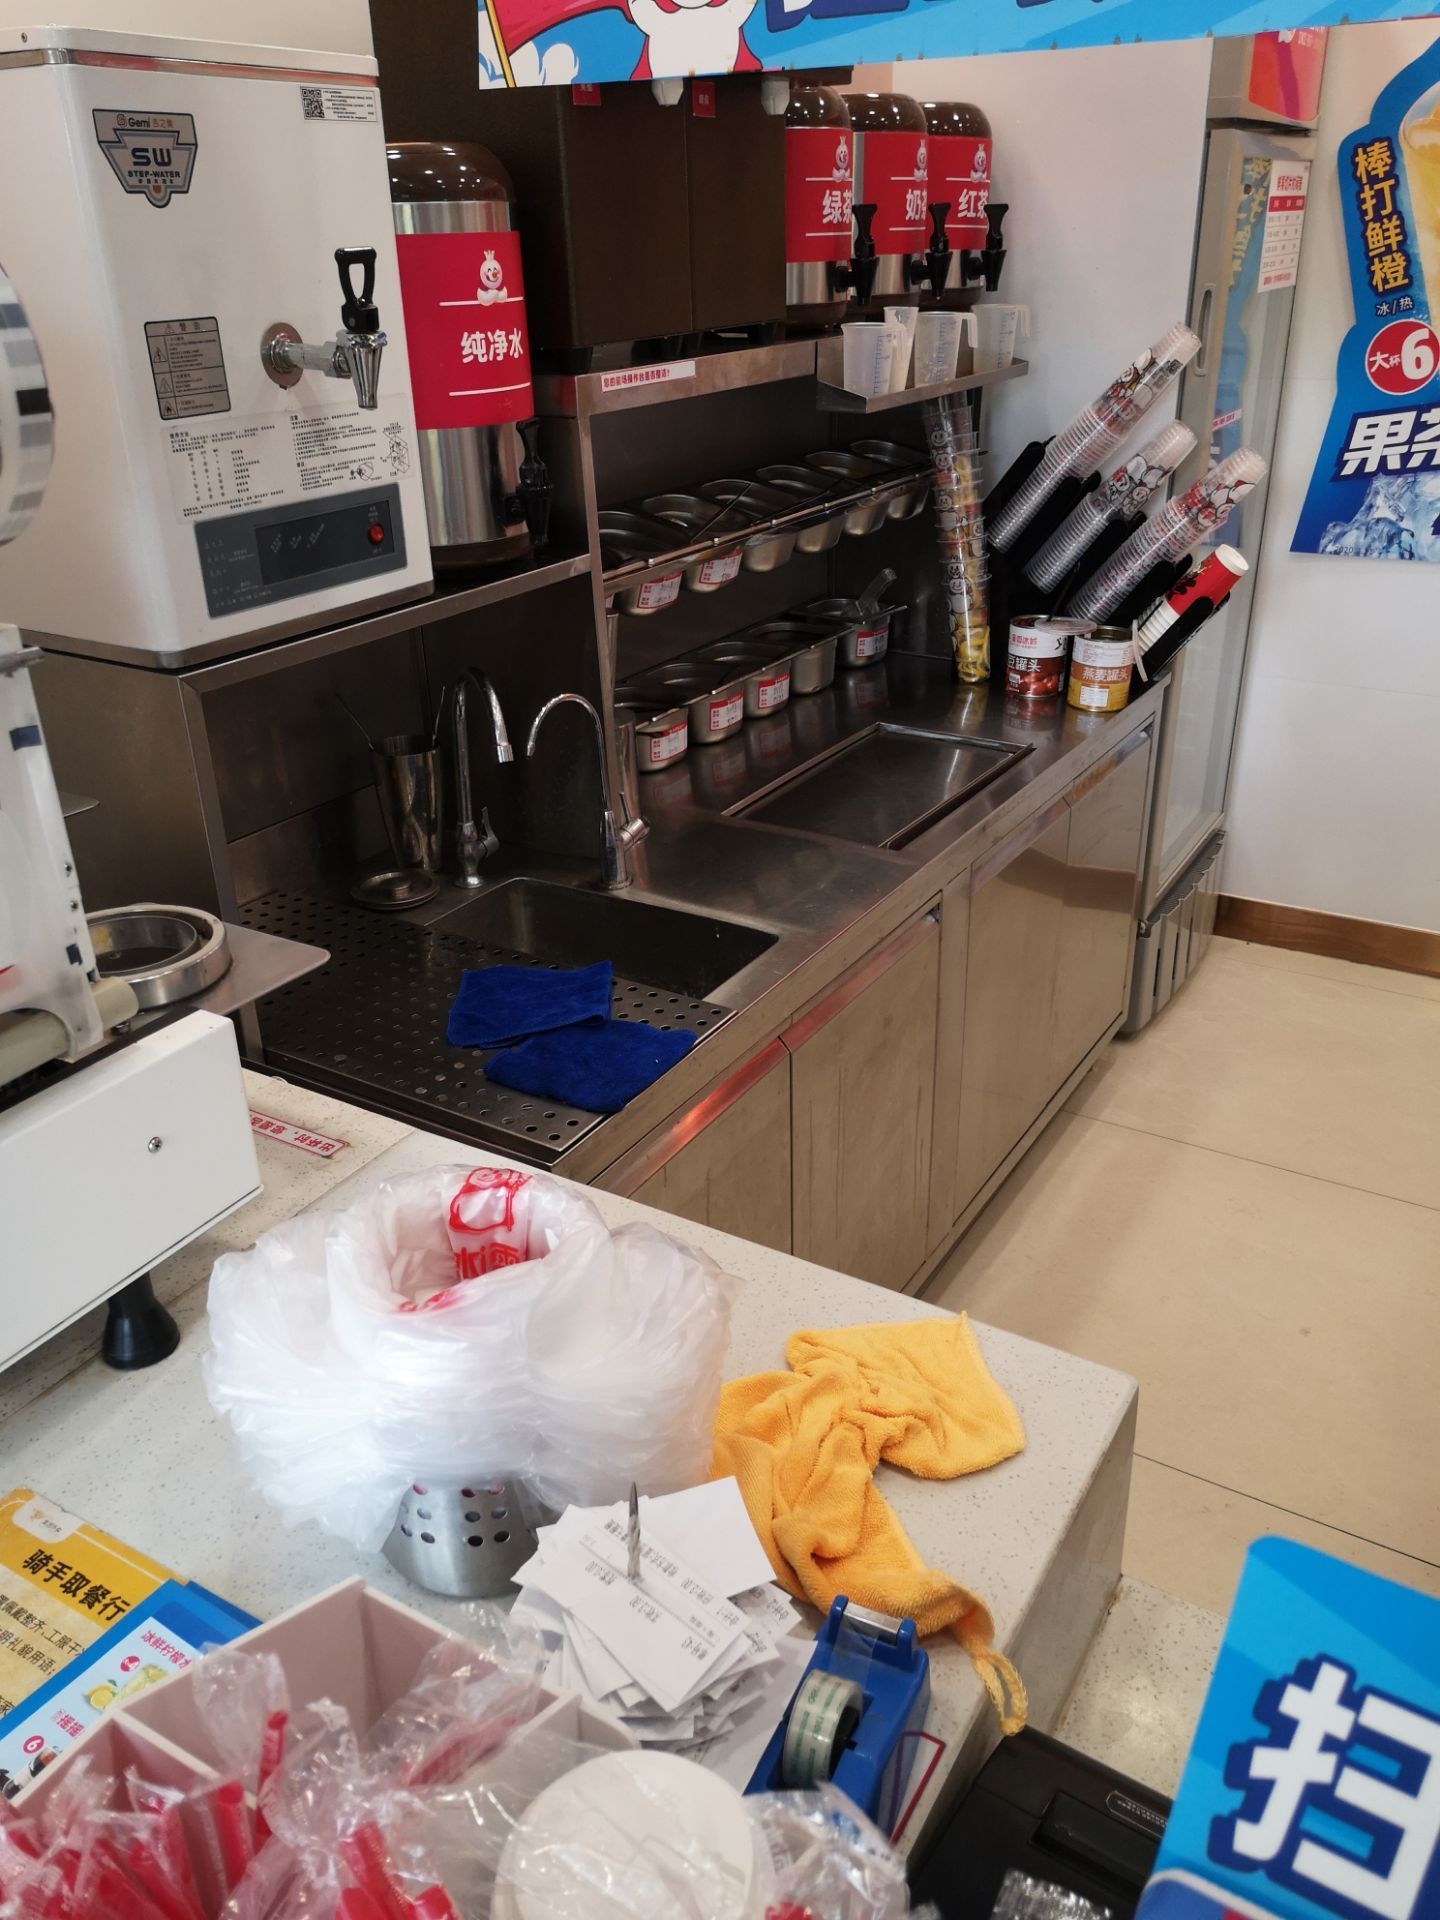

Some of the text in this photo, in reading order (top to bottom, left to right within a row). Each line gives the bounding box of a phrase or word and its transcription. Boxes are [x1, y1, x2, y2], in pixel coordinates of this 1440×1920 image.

[128, 117, 151, 128] Gemi
[131, 147, 172, 167] SW
[128, 170, 180, 178] STEP-WATER
[1354, 140, 1410, 293] 棒打鲜橙
[1375, 296, 1414, 317] 冰/热
[460, 327, 524, 364] 纯净水
[21, 1548, 131, 1621] 骑手取餐行
[1233, 1661, 1440, 1920] 扫
